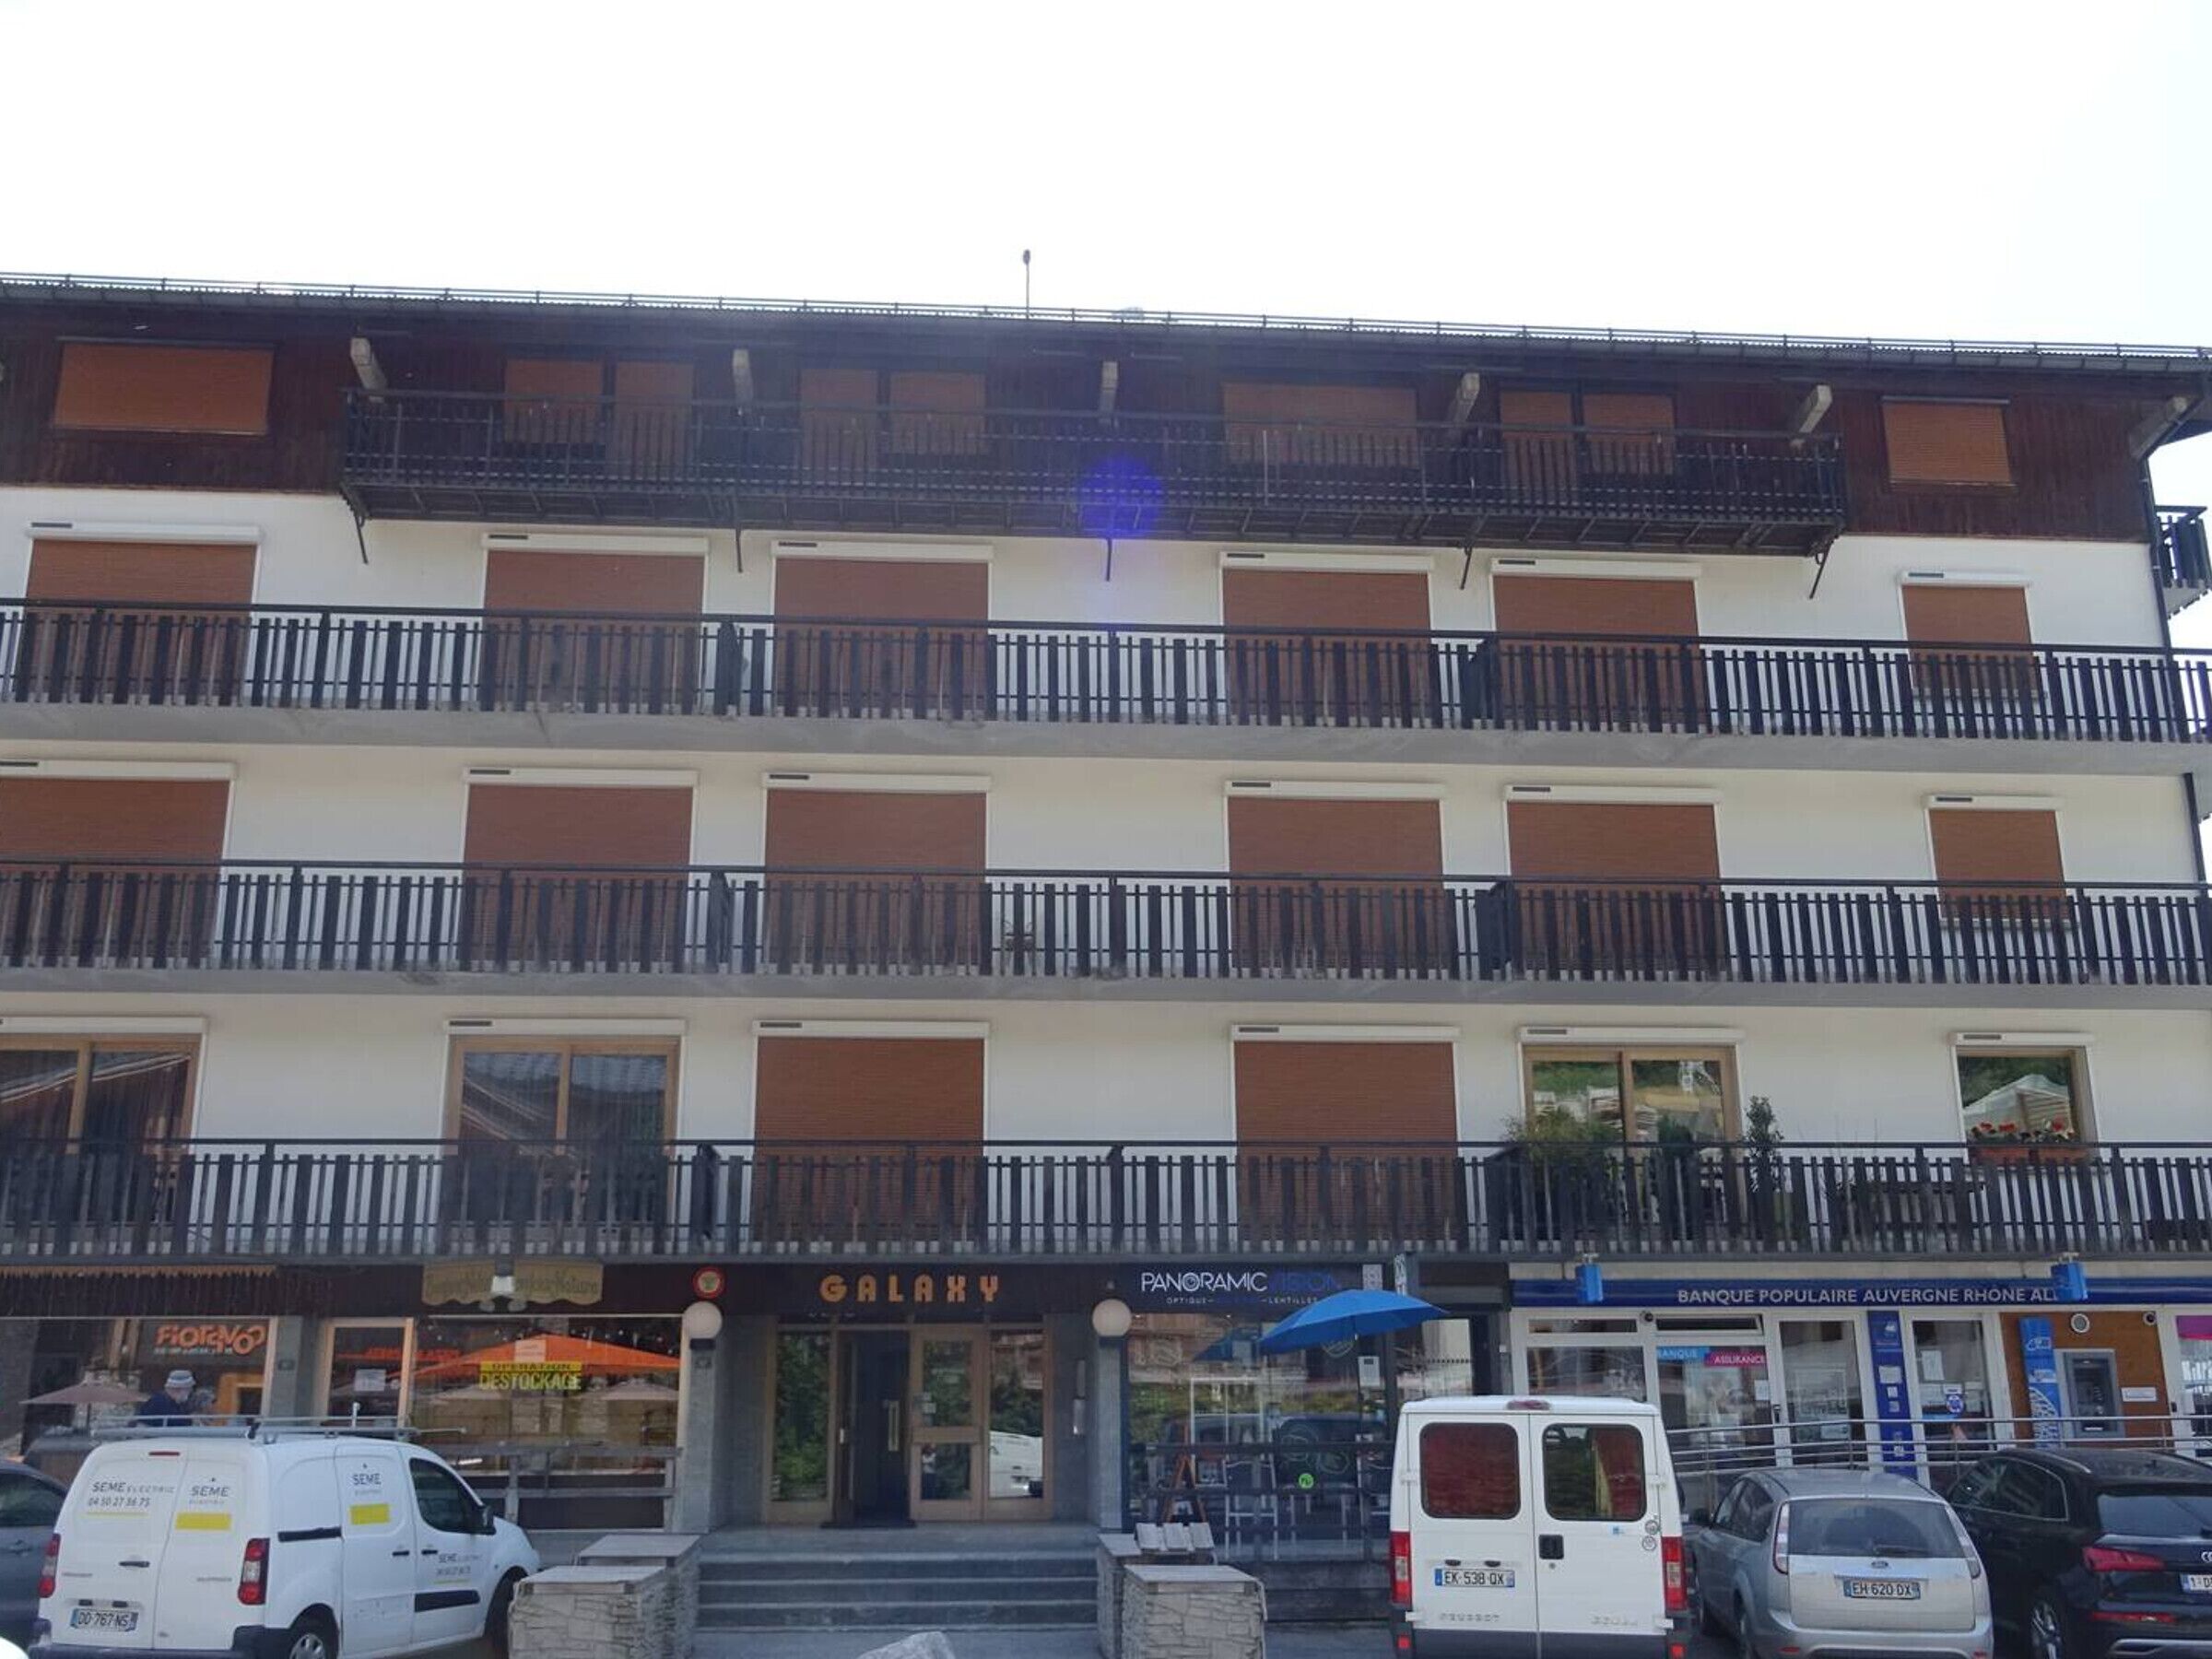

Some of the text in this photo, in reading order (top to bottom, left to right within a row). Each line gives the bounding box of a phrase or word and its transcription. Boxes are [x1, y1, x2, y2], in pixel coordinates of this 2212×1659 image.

[820, 1275, 998, 1302] GALAXY
[1141, 1272, 1267, 1291] PANORAMIC
[1678, 1289, 1753, 1304] BANQUE
[1759, 1289, 1856, 1302] POPULAIRE
[1863, 1288, 1959, 1302] AUVERGNE
[480, 1371, 582, 1390] DESTOCKAGE
[92, 1481, 126, 1492] SEME
[353, 1473, 382, 1485] SEME
[191, 1485, 229, 1497] SEME
